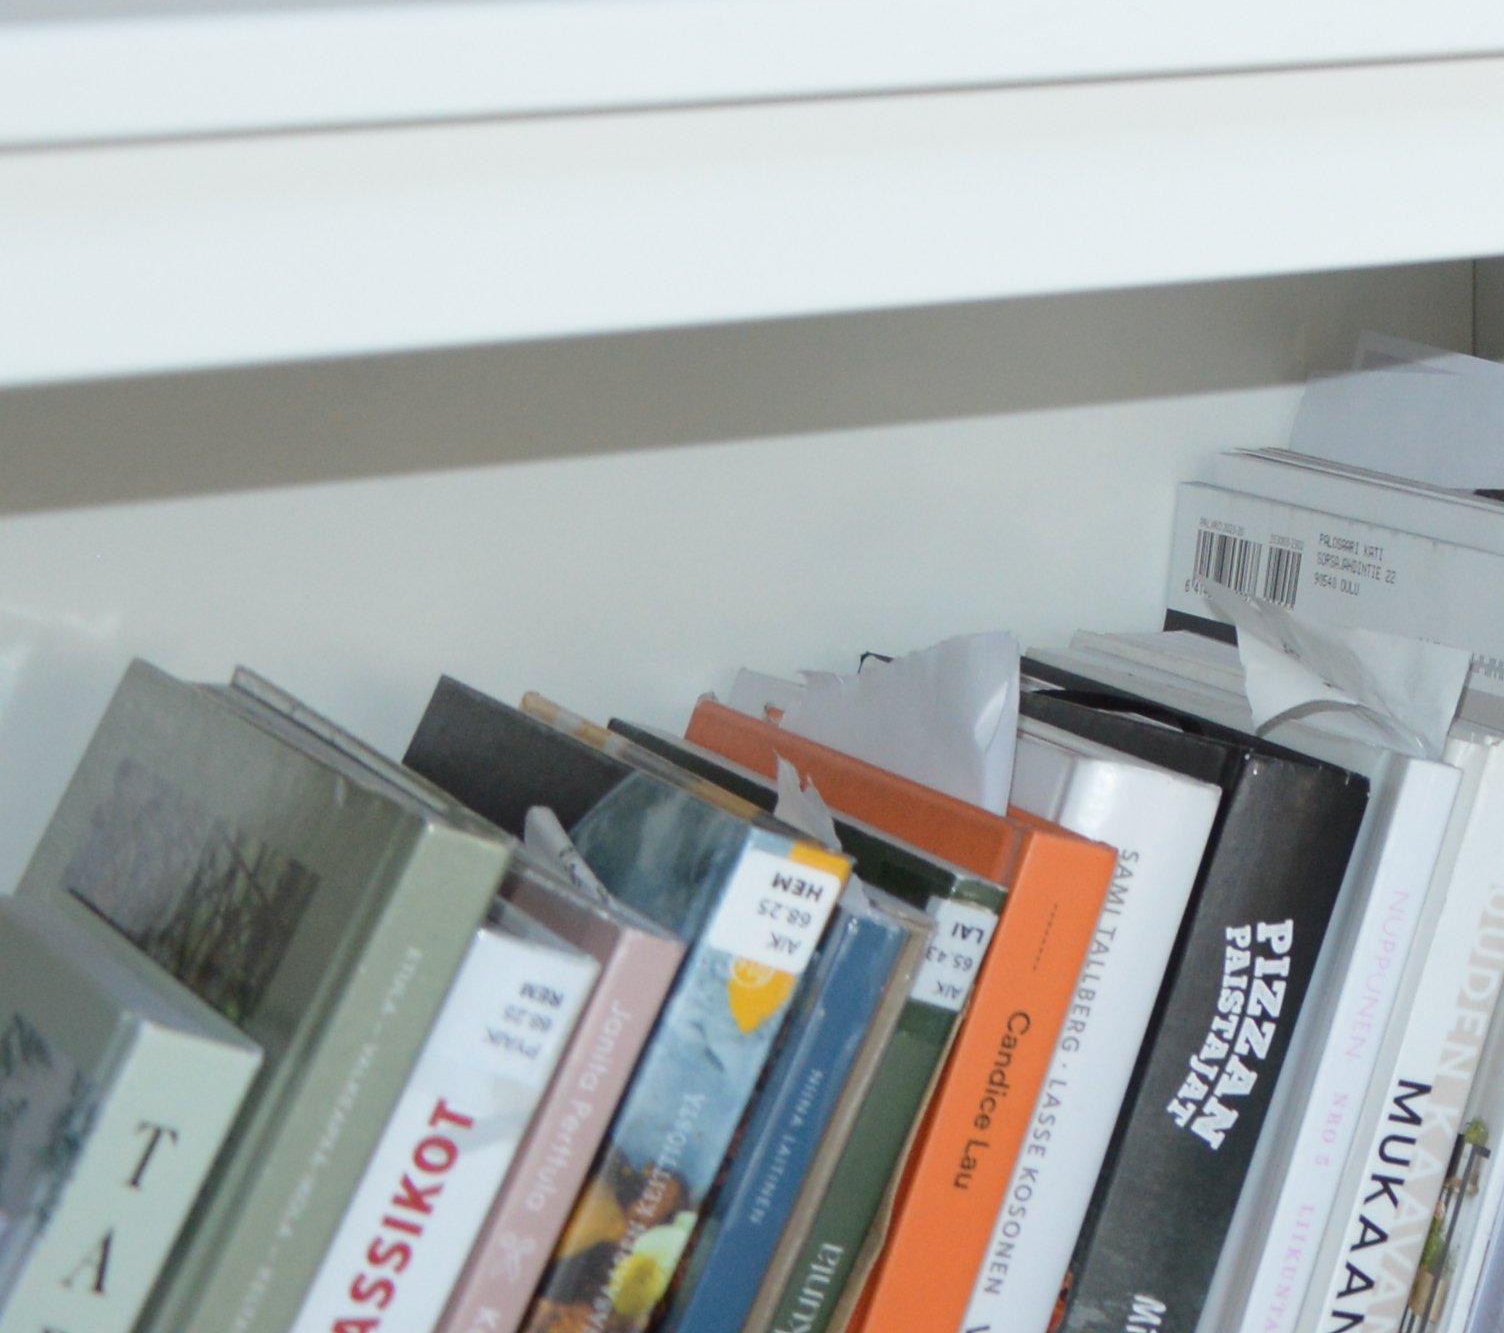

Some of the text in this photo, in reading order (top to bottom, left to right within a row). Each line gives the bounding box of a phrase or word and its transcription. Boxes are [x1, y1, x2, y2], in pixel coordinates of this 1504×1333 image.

[1363, 542, 1384, 560] KATI
[1384, 569, 1396, 585] 22
[756, 897, 812, 930] 68.25
[771, 870, 823, 901] HEM
[1100, 849, 1139, 914] SAMI
[765, 928, 803, 955] AIK
[950, 919, 984, 944] LAI
[931, 979, 963, 1001] AIK
[1058, 925, 1120, 1053] TALLBERG
[1346, 890, 1410, 1059] NUPPUNEN
[581, 1002, 635, 1091] Janita
[1165, 923, 1252, 1129] PAISTAJAT
[1184, 919, 1294, 1151] PIZZAN
[953, 1011, 1031, 1191] Candice Lau
[1030, 1080, 1070, 1158] LASSE
[1318, 1091, 1348, 1143] NRO
[526, 1099, 594, 1213] Perttula
[750, 1068, 823, 1224] NIINA LAITINEN
[981, 1167, 1038, 1296] KOSONEN
